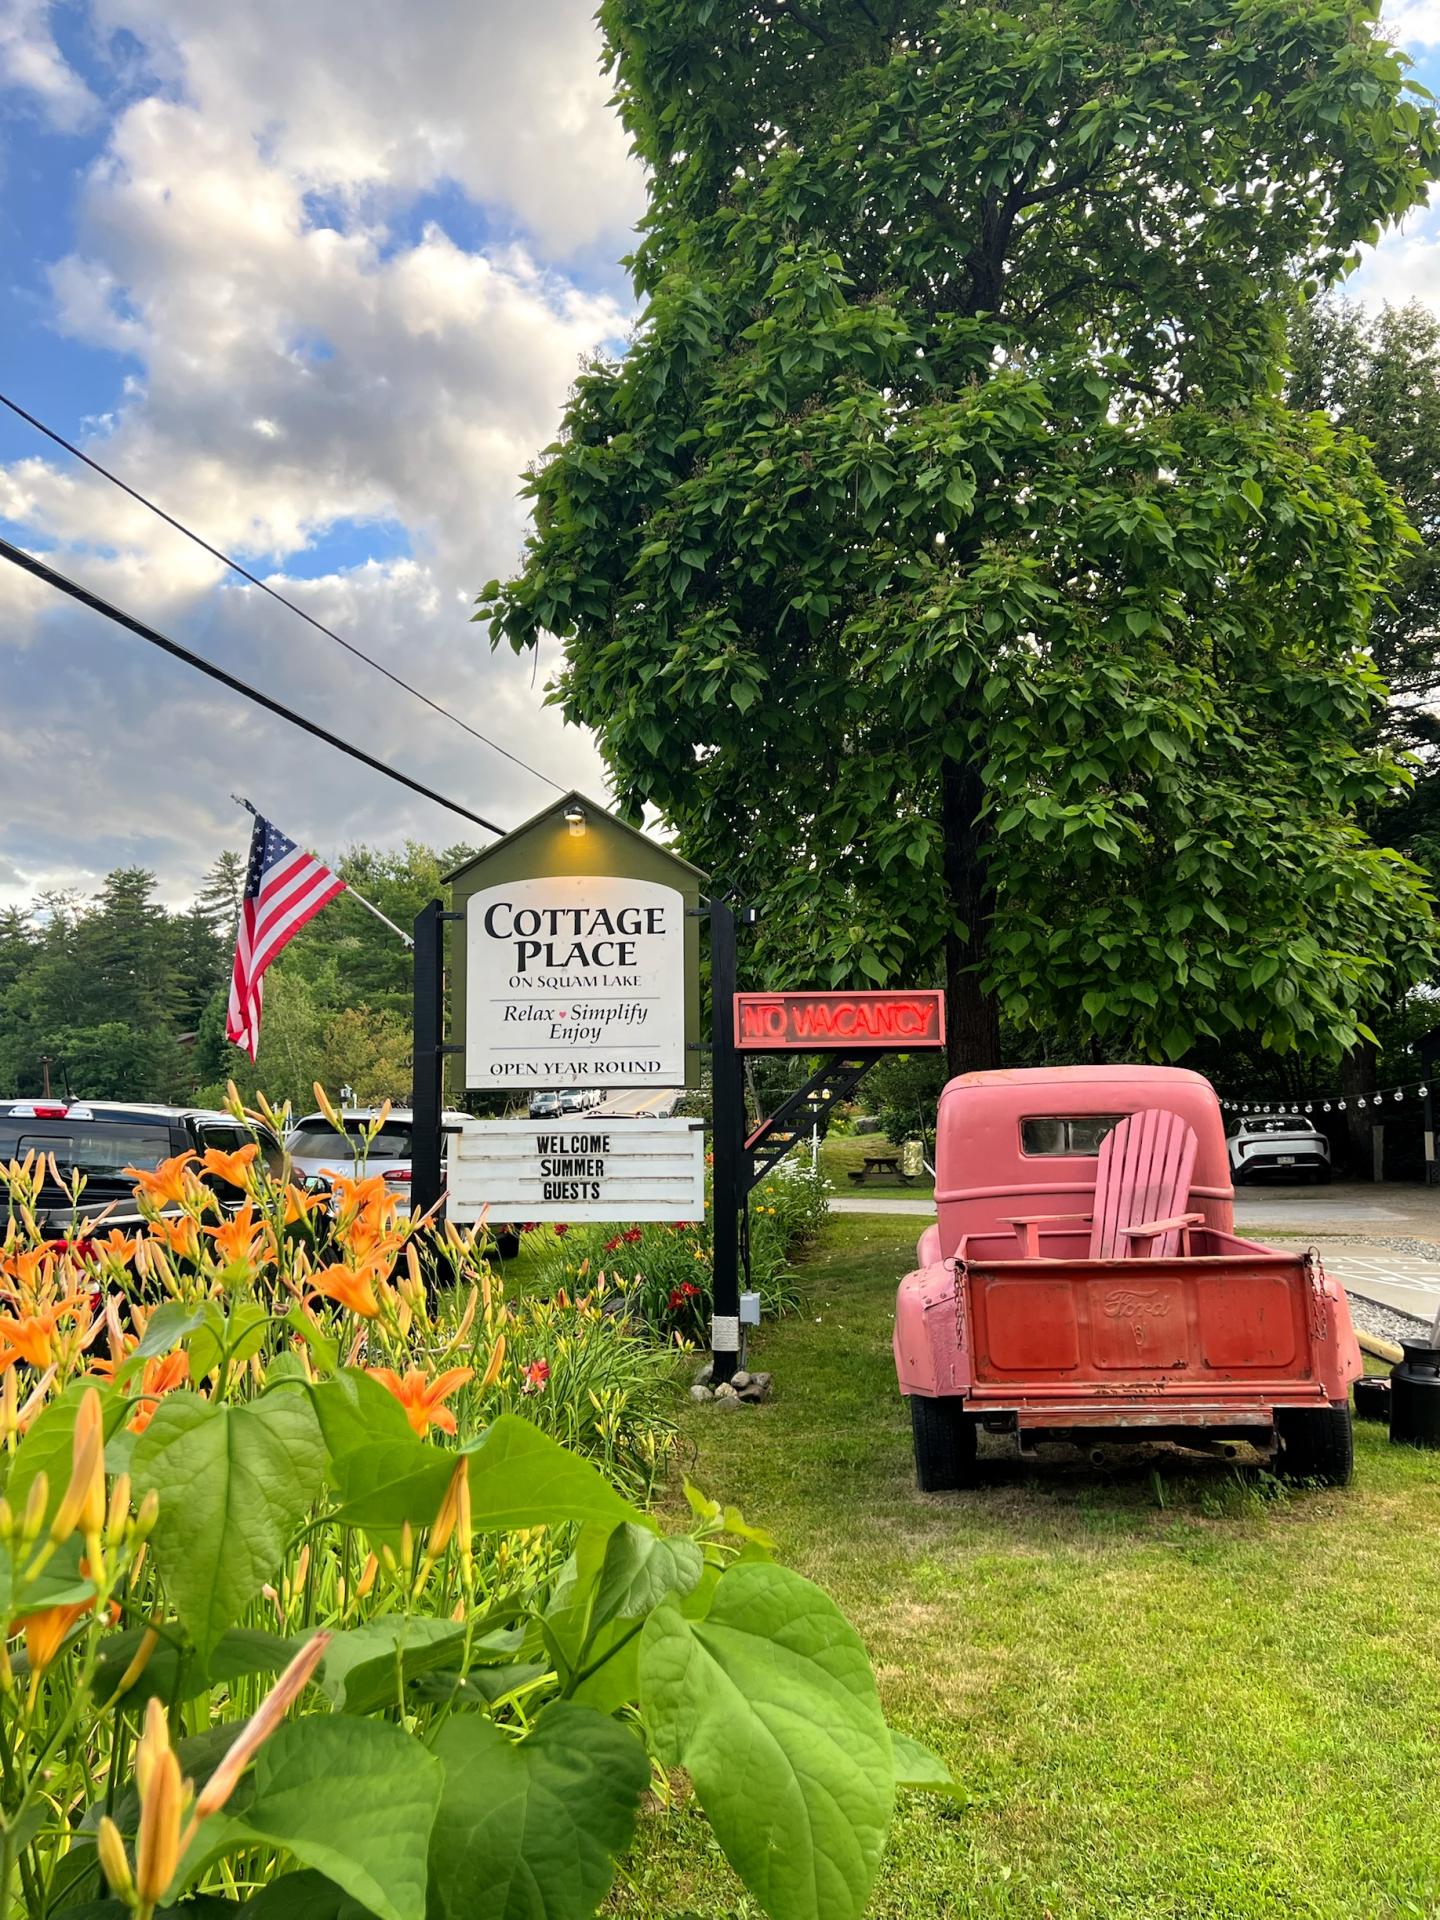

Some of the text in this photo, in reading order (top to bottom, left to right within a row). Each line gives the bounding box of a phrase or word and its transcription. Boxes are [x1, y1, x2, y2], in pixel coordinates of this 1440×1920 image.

[484, 902, 666, 939] COTTAGE
[513, 940, 638, 973] PLACE
[509, 974, 642, 990] ON SQUAM LAKE
[503, 1003, 648, 1026] Relax Simplify
[743, 1001, 935, 1038] NO VACANCY
[549, 1023, 602, 1045] Enjoy
[490, 1060, 661, 1076] OPEN YEAR ROUND
[536, 1135, 611, 1154] WELCOME
[540, 1159, 605, 1177] SUMMER
[543, 1182, 601, 1200] GUESTS
[1103, 1289, 1170, 1319] Ford
